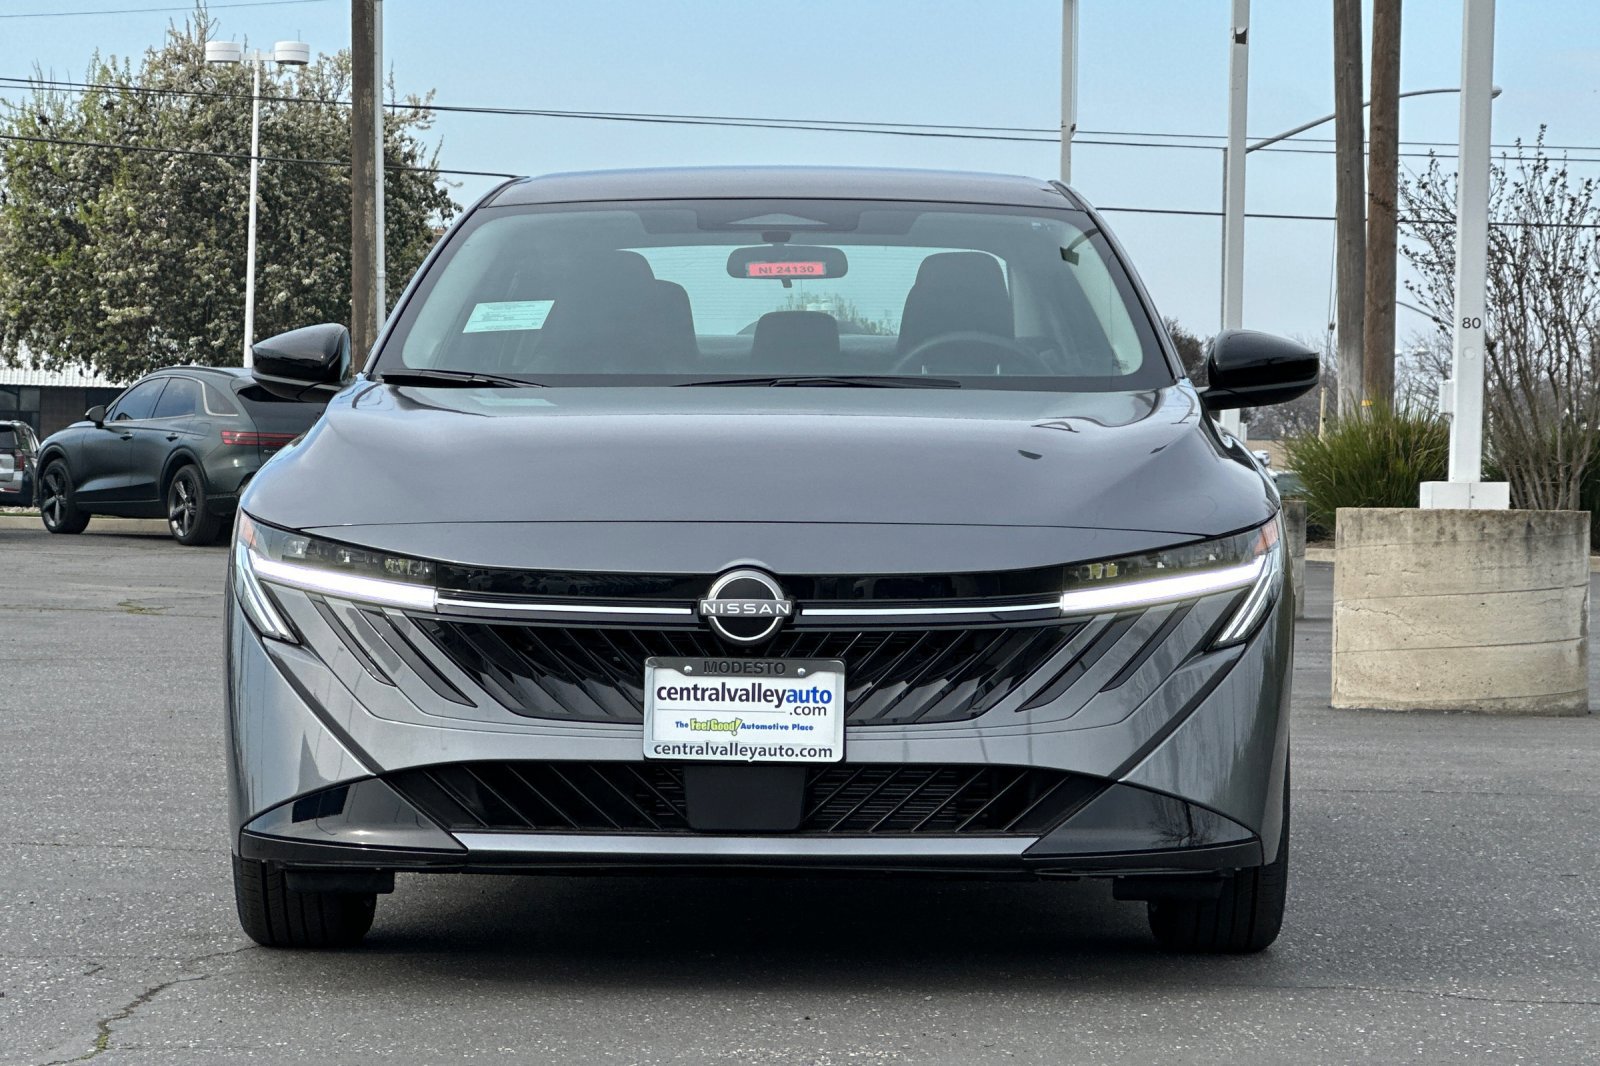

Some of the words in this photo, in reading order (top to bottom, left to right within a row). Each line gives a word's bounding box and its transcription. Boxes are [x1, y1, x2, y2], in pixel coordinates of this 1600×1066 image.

[776, 265, 815, 274] 24130
[1462, 317, 1482, 329] 80
[702, 603, 790, 614] NISSAN
[703, 660, 786, 675] MODESTO
[656, 682, 833, 709] centralvalleyauto
[789, 704, 827, 716] .com
[675, 721, 689, 729] The
[740, 722, 789, 731] Automotive
[791, 723, 814, 731] Place
[653, 742, 833, 760] centralvalleyauto.com
